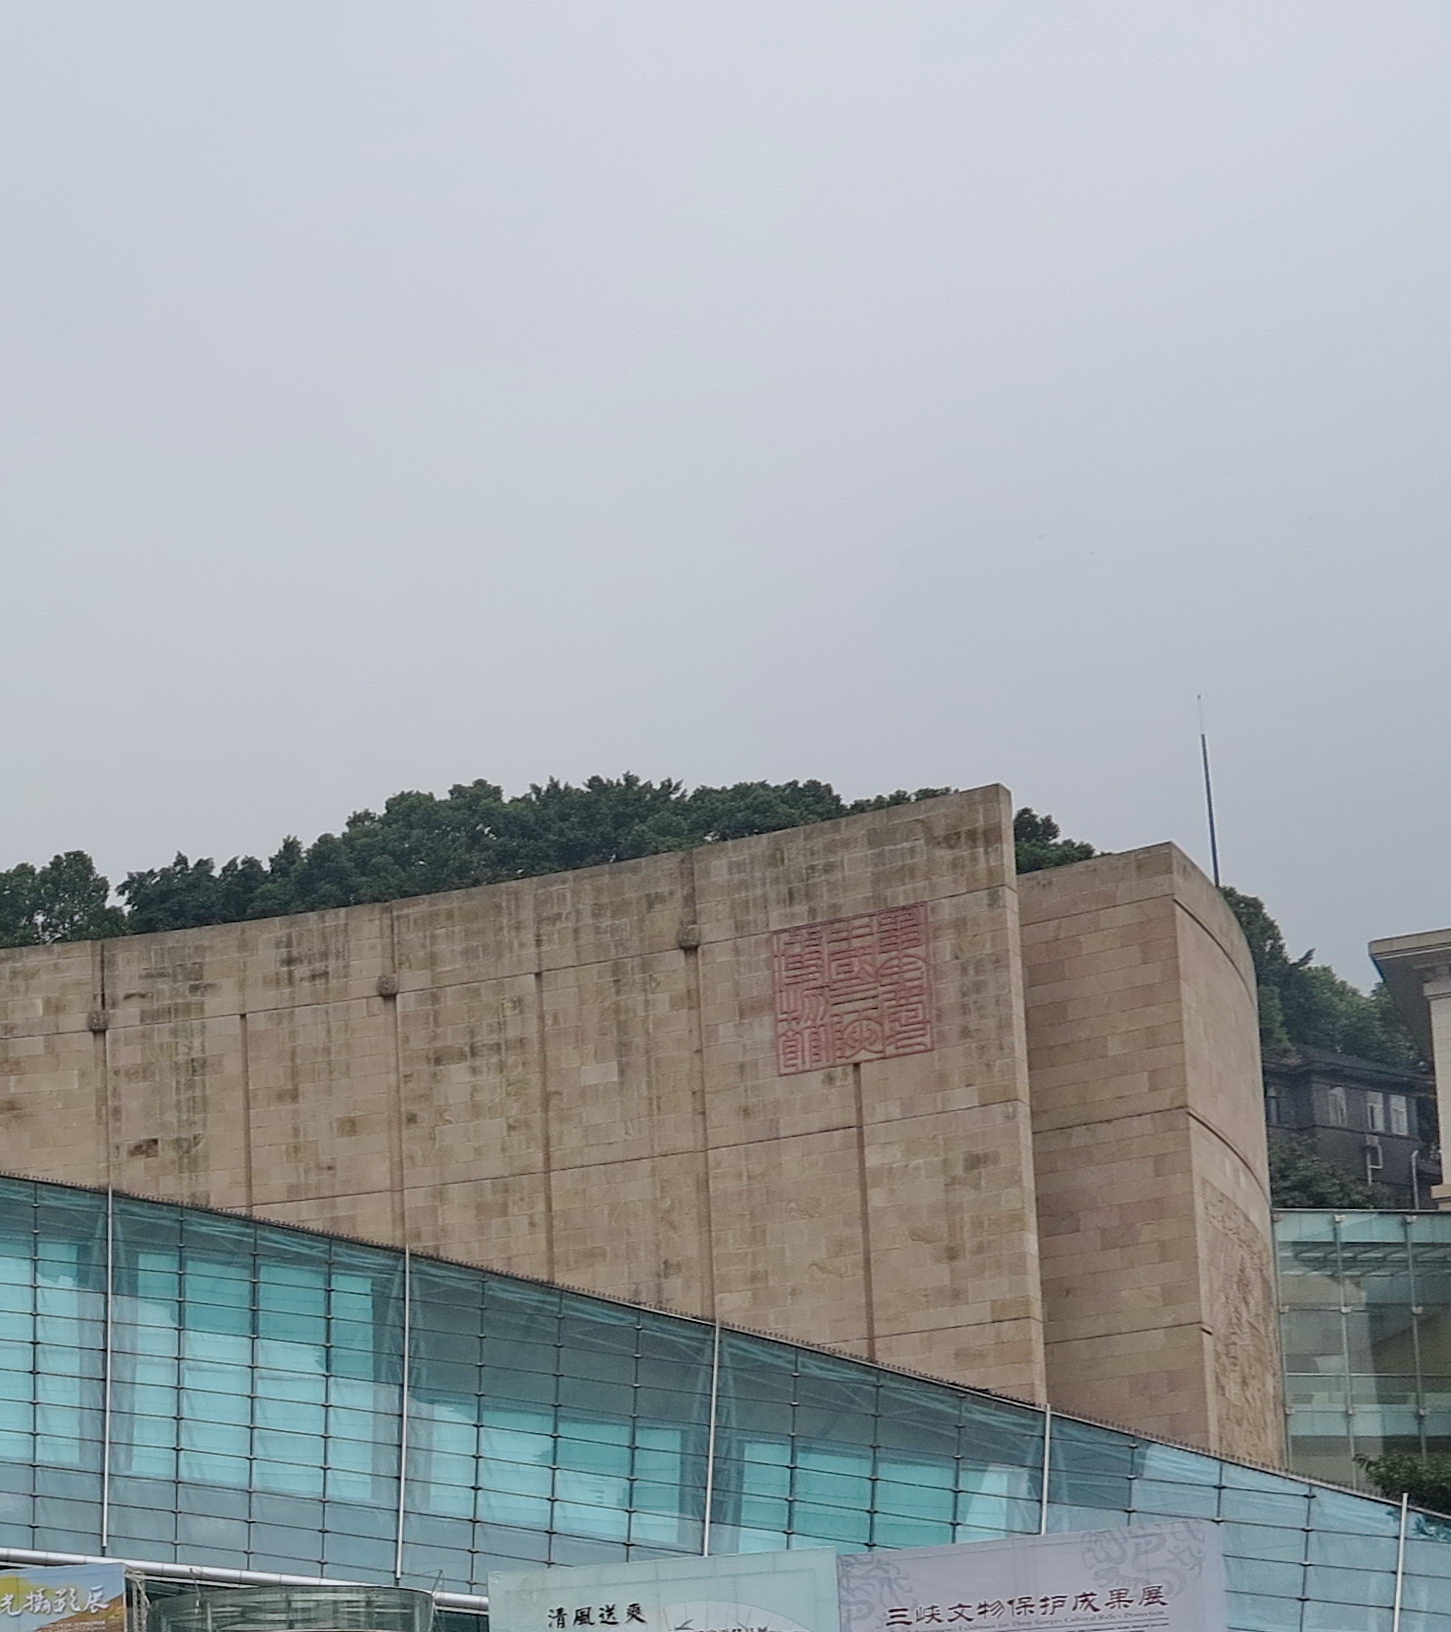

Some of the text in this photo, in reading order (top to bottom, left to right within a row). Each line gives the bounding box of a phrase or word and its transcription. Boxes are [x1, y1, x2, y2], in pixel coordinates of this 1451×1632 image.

[885, 1584, 1169, 1627] 三峡文物保护成果展
